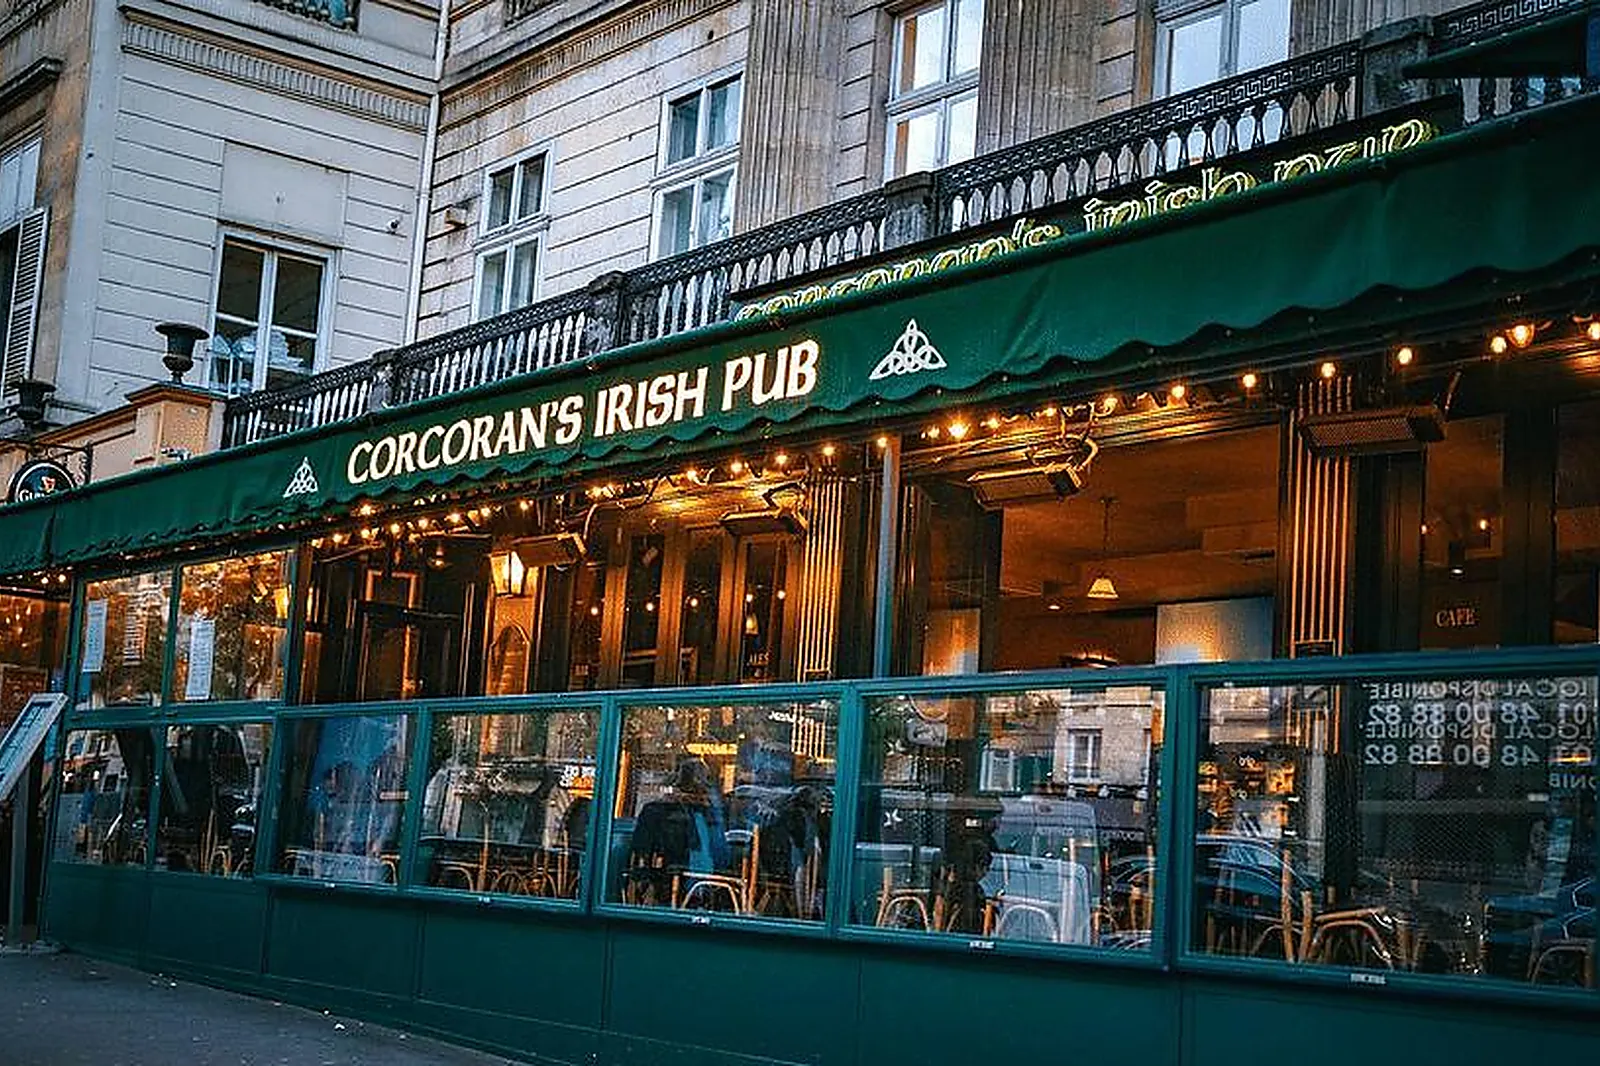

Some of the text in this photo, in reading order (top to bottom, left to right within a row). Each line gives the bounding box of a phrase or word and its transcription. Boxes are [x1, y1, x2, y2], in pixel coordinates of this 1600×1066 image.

[347, 339, 820, 484] CORCORAN'S IRISH PUB
